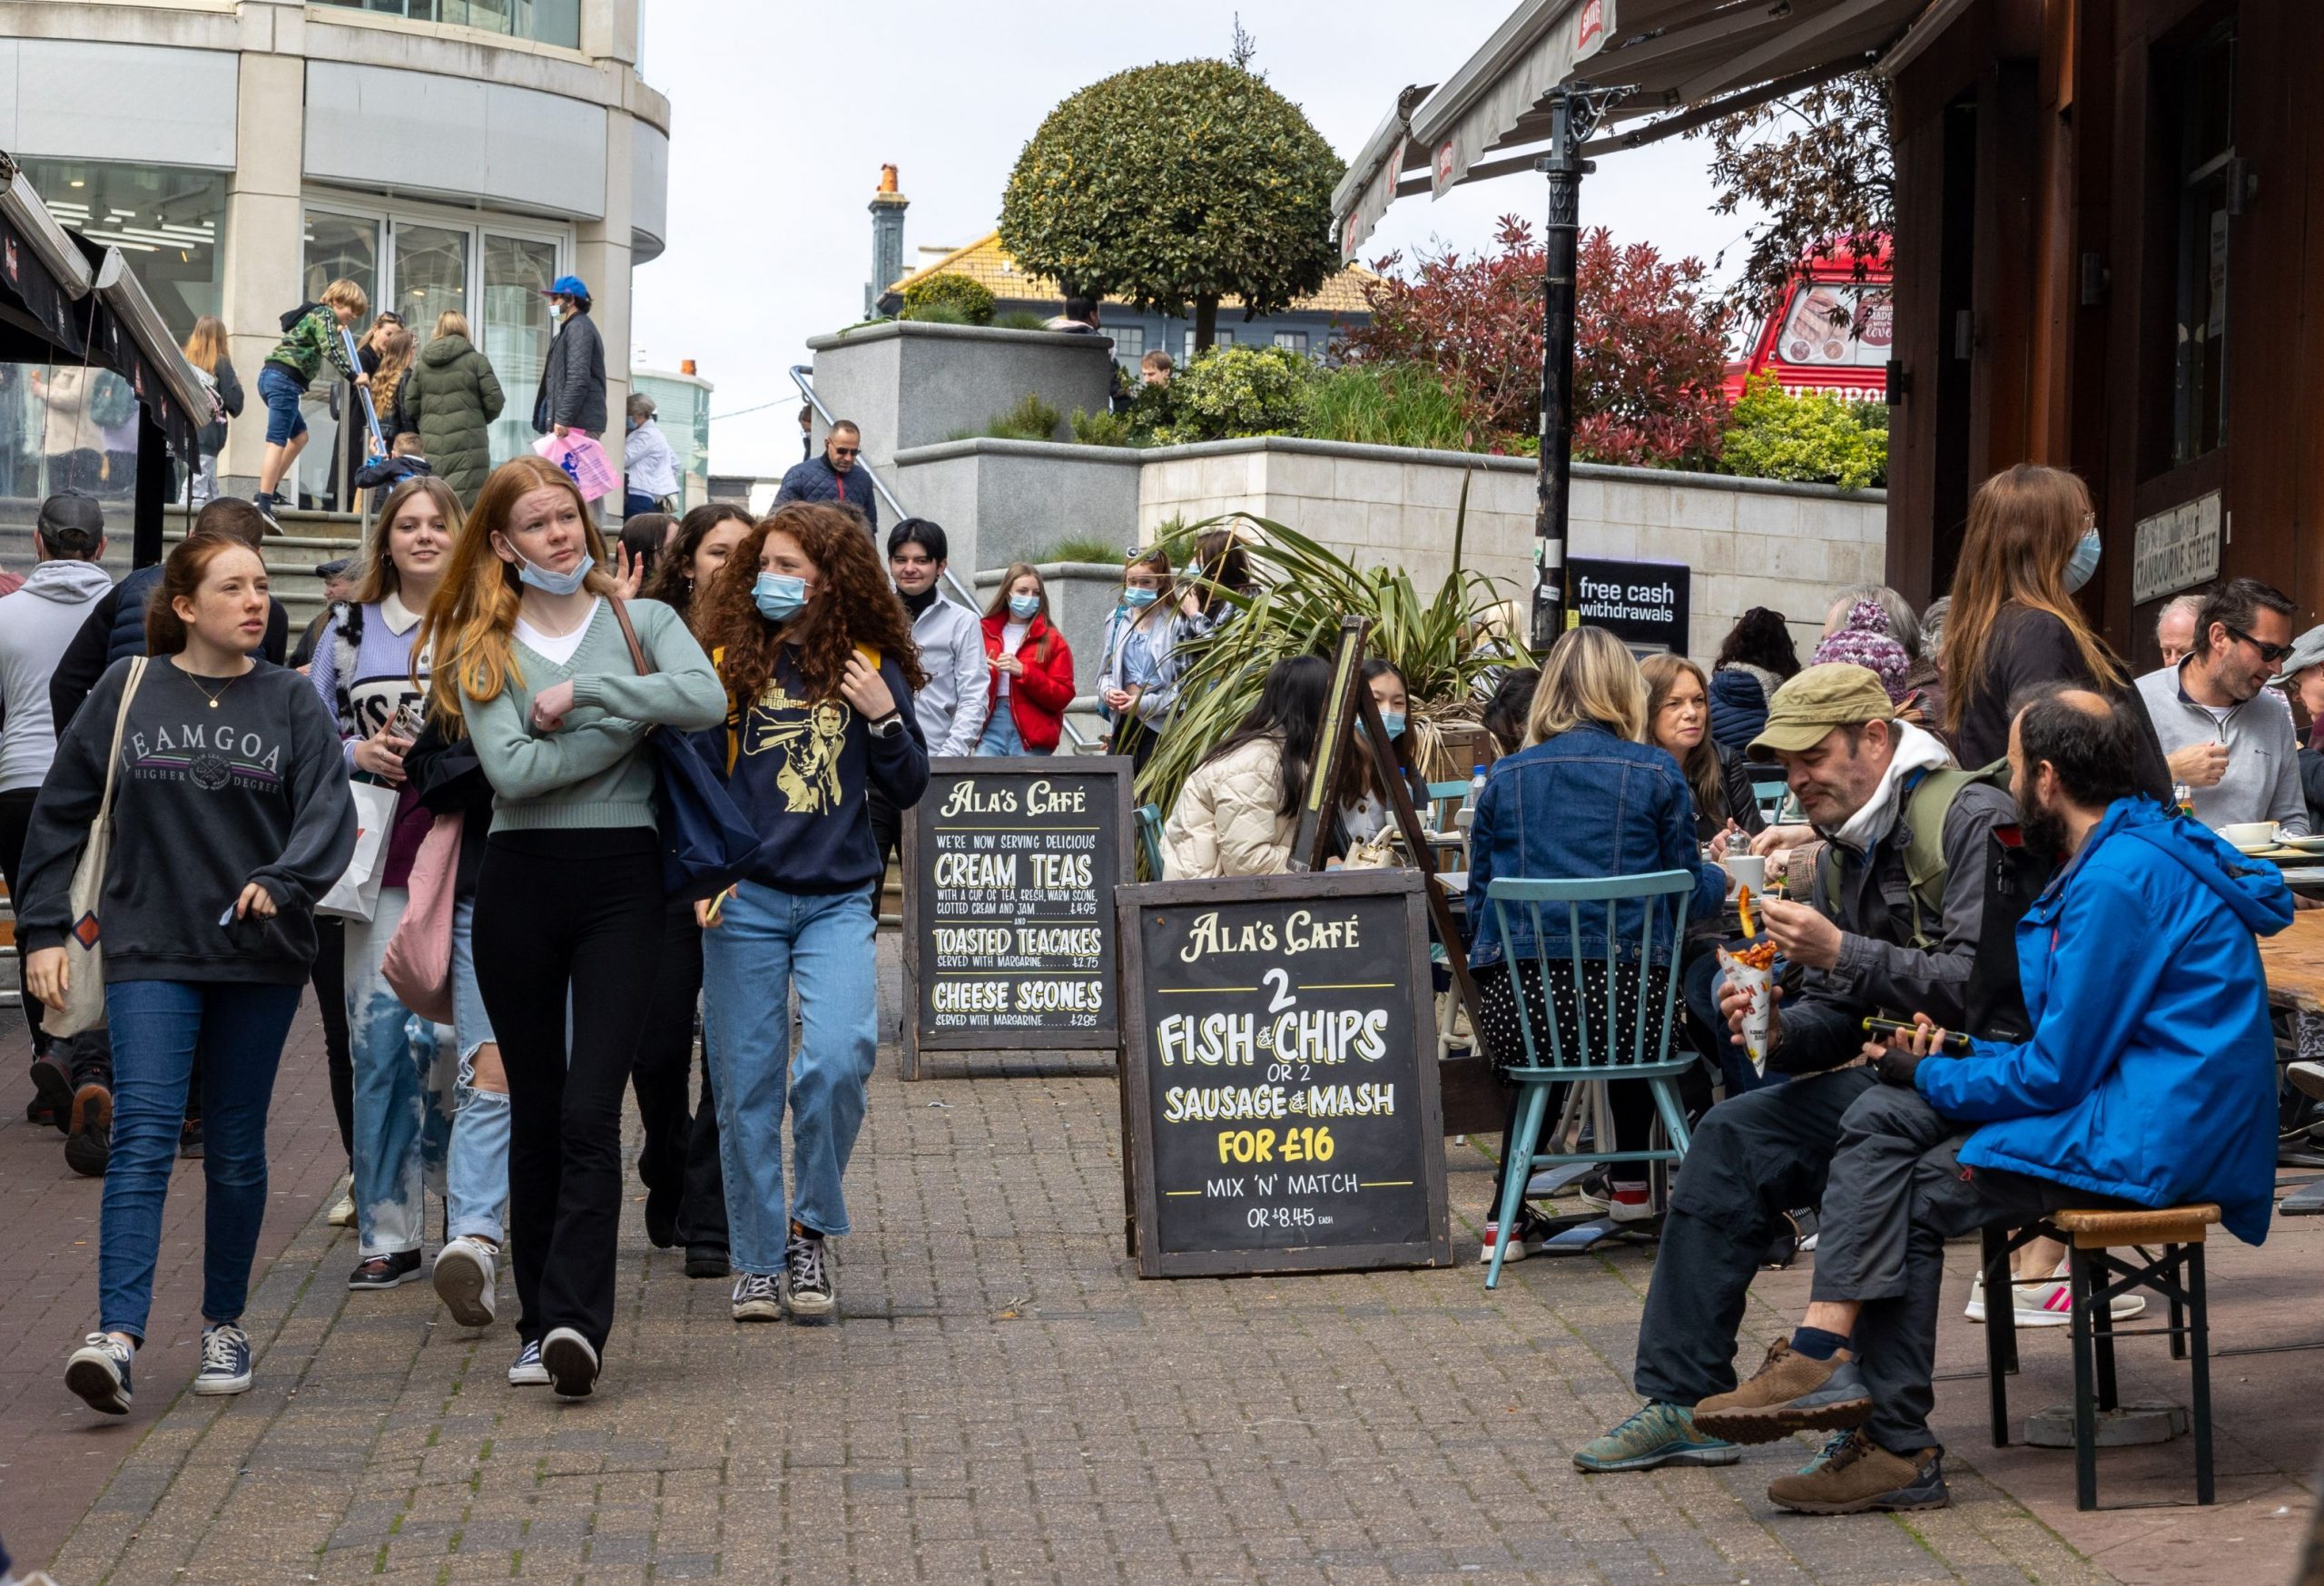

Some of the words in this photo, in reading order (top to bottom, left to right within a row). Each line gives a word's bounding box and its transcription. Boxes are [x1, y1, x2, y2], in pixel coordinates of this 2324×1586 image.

[2188, 531, 2216, 574] STREET
[1580, 576, 1621, 600] free
[1628, 582, 1674, 604] cash
[1580, 601, 1673, 622] withdrawals
[136, 769, 185, 782] HIGHER
[233, 776, 280, 793] DEGREE
[936, 835, 966, 849] WE'RE
[974, 835, 995, 849] NOW
[1000, 835, 1040, 849] SERVING
[1046, 835, 1096, 849] DELICIOUS
[934, 852, 1017, 888] CREAM
[1029, 853, 1093, 889] TEAS
[937, 889, 957, 901] WITH
[960, 890, 966, 901] A
[969, 890, 983, 901] CUP
[987, 890, 997, 901] OF
[1001, 890, 1018, 902] TEA,
[1048, 890, 1069, 901] WARM
[1072, 890, 1098, 902] SCONE,
[937, 902, 968, 914] CLOTTED
[971, 902, 996, 914] CREAM
[999, 902, 1014, 914] AND
[933, 928, 1011, 955] TOASTED
[1017, 928, 1101, 956] TEACAKES
[937, 956, 968, 967] SERVED
[972, 956, 993, 967] WITH
[1072, 957, 1098, 968] £2.75
[932, 981, 1009, 1011] CHEESE
[1015, 981, 1102, 1012] SCONES
[1262, 967, 1297, 1014] 2
[935, 1014, 967, 1026] SERVED
[970, 1014, 989, 1026] WITH
[1157, 1013, 1254, 1066] FISH
[1257, 1026, 1273, 1049] &
[1272, 1010, 1388, 1064] CHIPS
[1267, 1064, 1292, 1082] OR
[1300, 1064, 1311, 1081] 2
[1164, 1084, 1287, 1122] SAUSAGE
[1289, 1090, 1307, 1113] &
[1307, 1083, 1394, 1117] MASH
[1218, 1128, 1276, 1163] FOR
[1278, 1127, 1334, 1162] £16
[1206, 1178, 1245, 1197] MIX
[1288, 1174, 1358, 1195] MATCH
[1247, 1208, 1270, 1227] OR
[1272, 1207, 1315, 1226] £8.45
[1318, 1216, 1334, 1225] EACH
